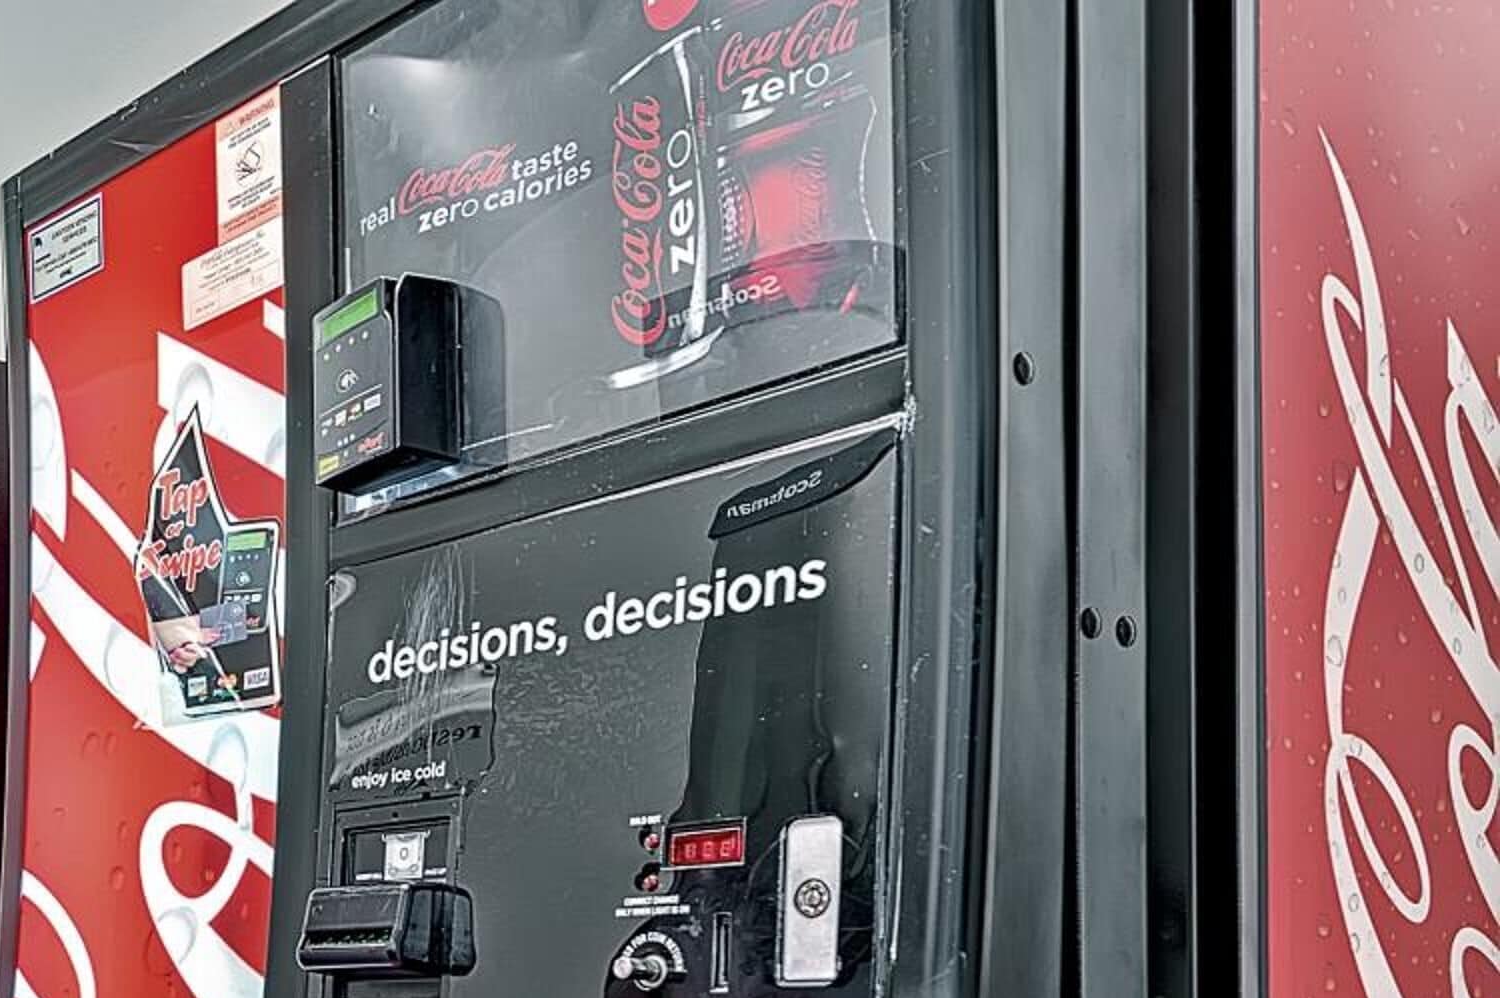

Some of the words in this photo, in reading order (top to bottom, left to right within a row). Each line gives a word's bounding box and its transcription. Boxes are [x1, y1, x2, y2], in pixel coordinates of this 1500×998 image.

[716, 0, 861, 92] Coca-Cola
[741, 62, 830, 112] zero
[359, 197, 396, 237] real
[397, 142, 517, 217] Coca-Cola
[511, 140, 578, 181] taste
[418, 198, 479, 235] zero
[483, 159, 592, 212] calories
[612, 95, 667, 346] Coca-Cola
[666, 129, 695, 274] zero
[158, 467, 209, 527] Tap
[164, 519, 184, 539] or
[139, 533, 222, 593] Swipe
[366, 613, 569, 684] decisions,
[584, 558, 828, 642] decisions
[351, 768, 388, 790] enjoy
[391, 766, 412, 782] ice
[414, 760, 446, 780] cold
